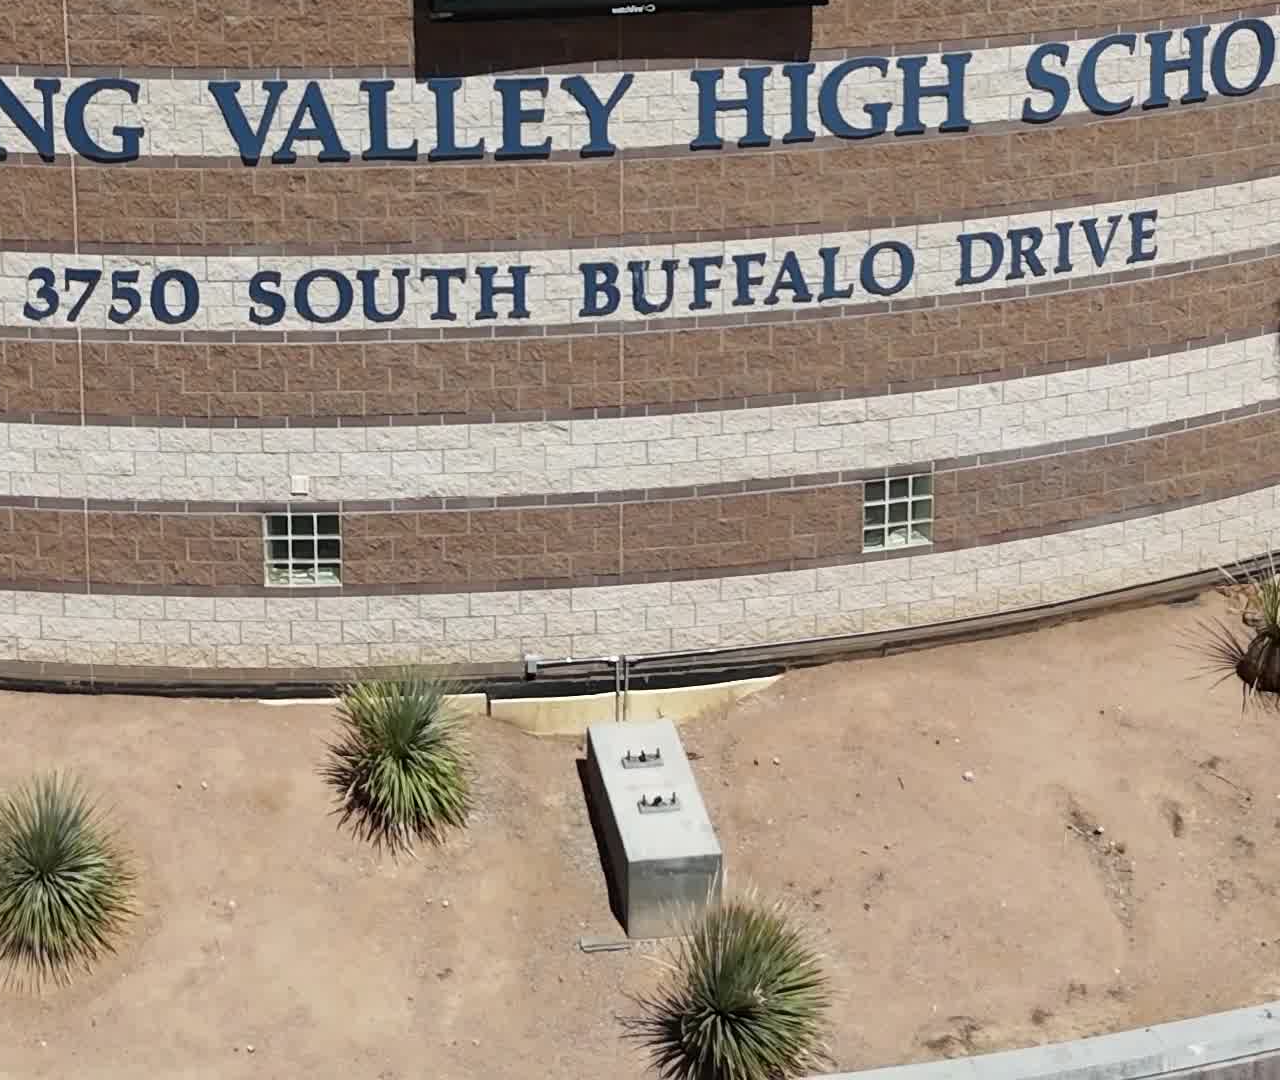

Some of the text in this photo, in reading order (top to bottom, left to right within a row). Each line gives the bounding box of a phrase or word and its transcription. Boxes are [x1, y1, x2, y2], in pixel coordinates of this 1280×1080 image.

[208, 73, 634, 166] VALLEY
[689, 52, 972, 151] HIGH
[23, 209, 1159, 325] 3750 SOUTH BUFFALO DRIVE
